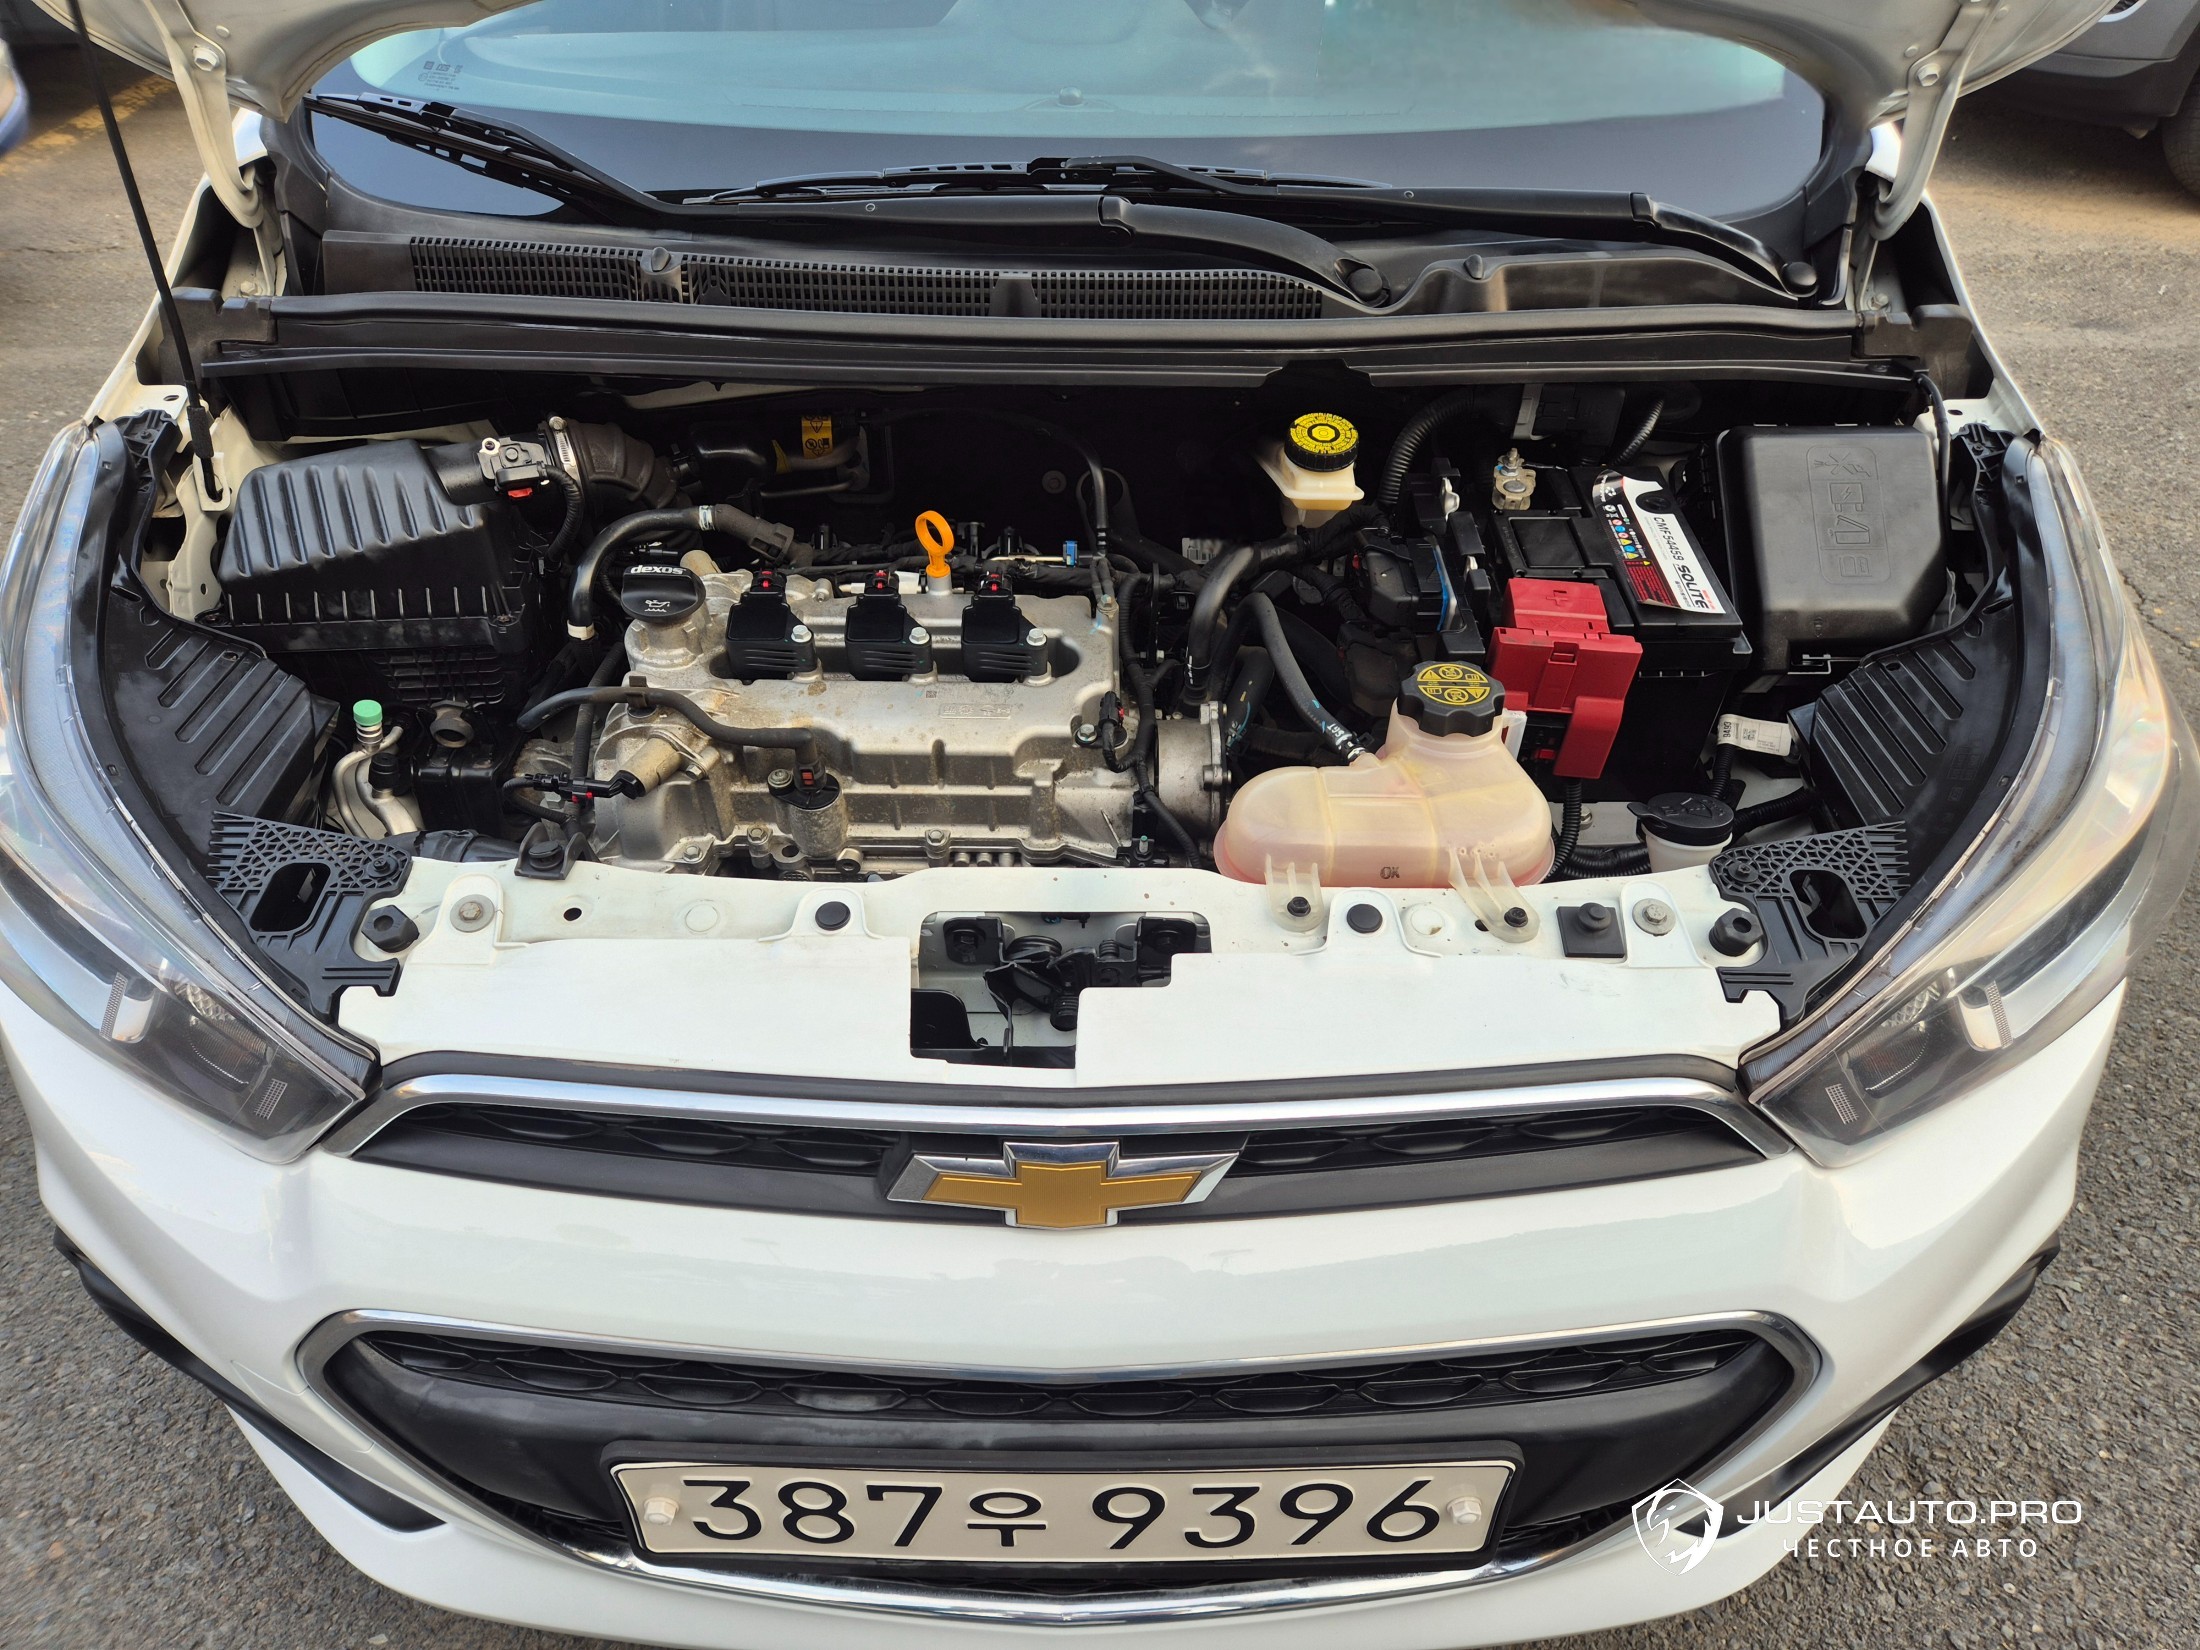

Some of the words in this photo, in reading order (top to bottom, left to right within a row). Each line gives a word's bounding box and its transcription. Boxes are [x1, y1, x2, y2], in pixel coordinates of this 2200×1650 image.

[1653, 516, 1685, 561] CMF54459
[630, 564, 684, 575] dexos
[1678, 564, 1710, 610] SOLITE
[1380, 866, 1400, 880] OK
[683, 1479, 1047, 1549] 387우
[1092, 1479, 1440, 1551] 9396
